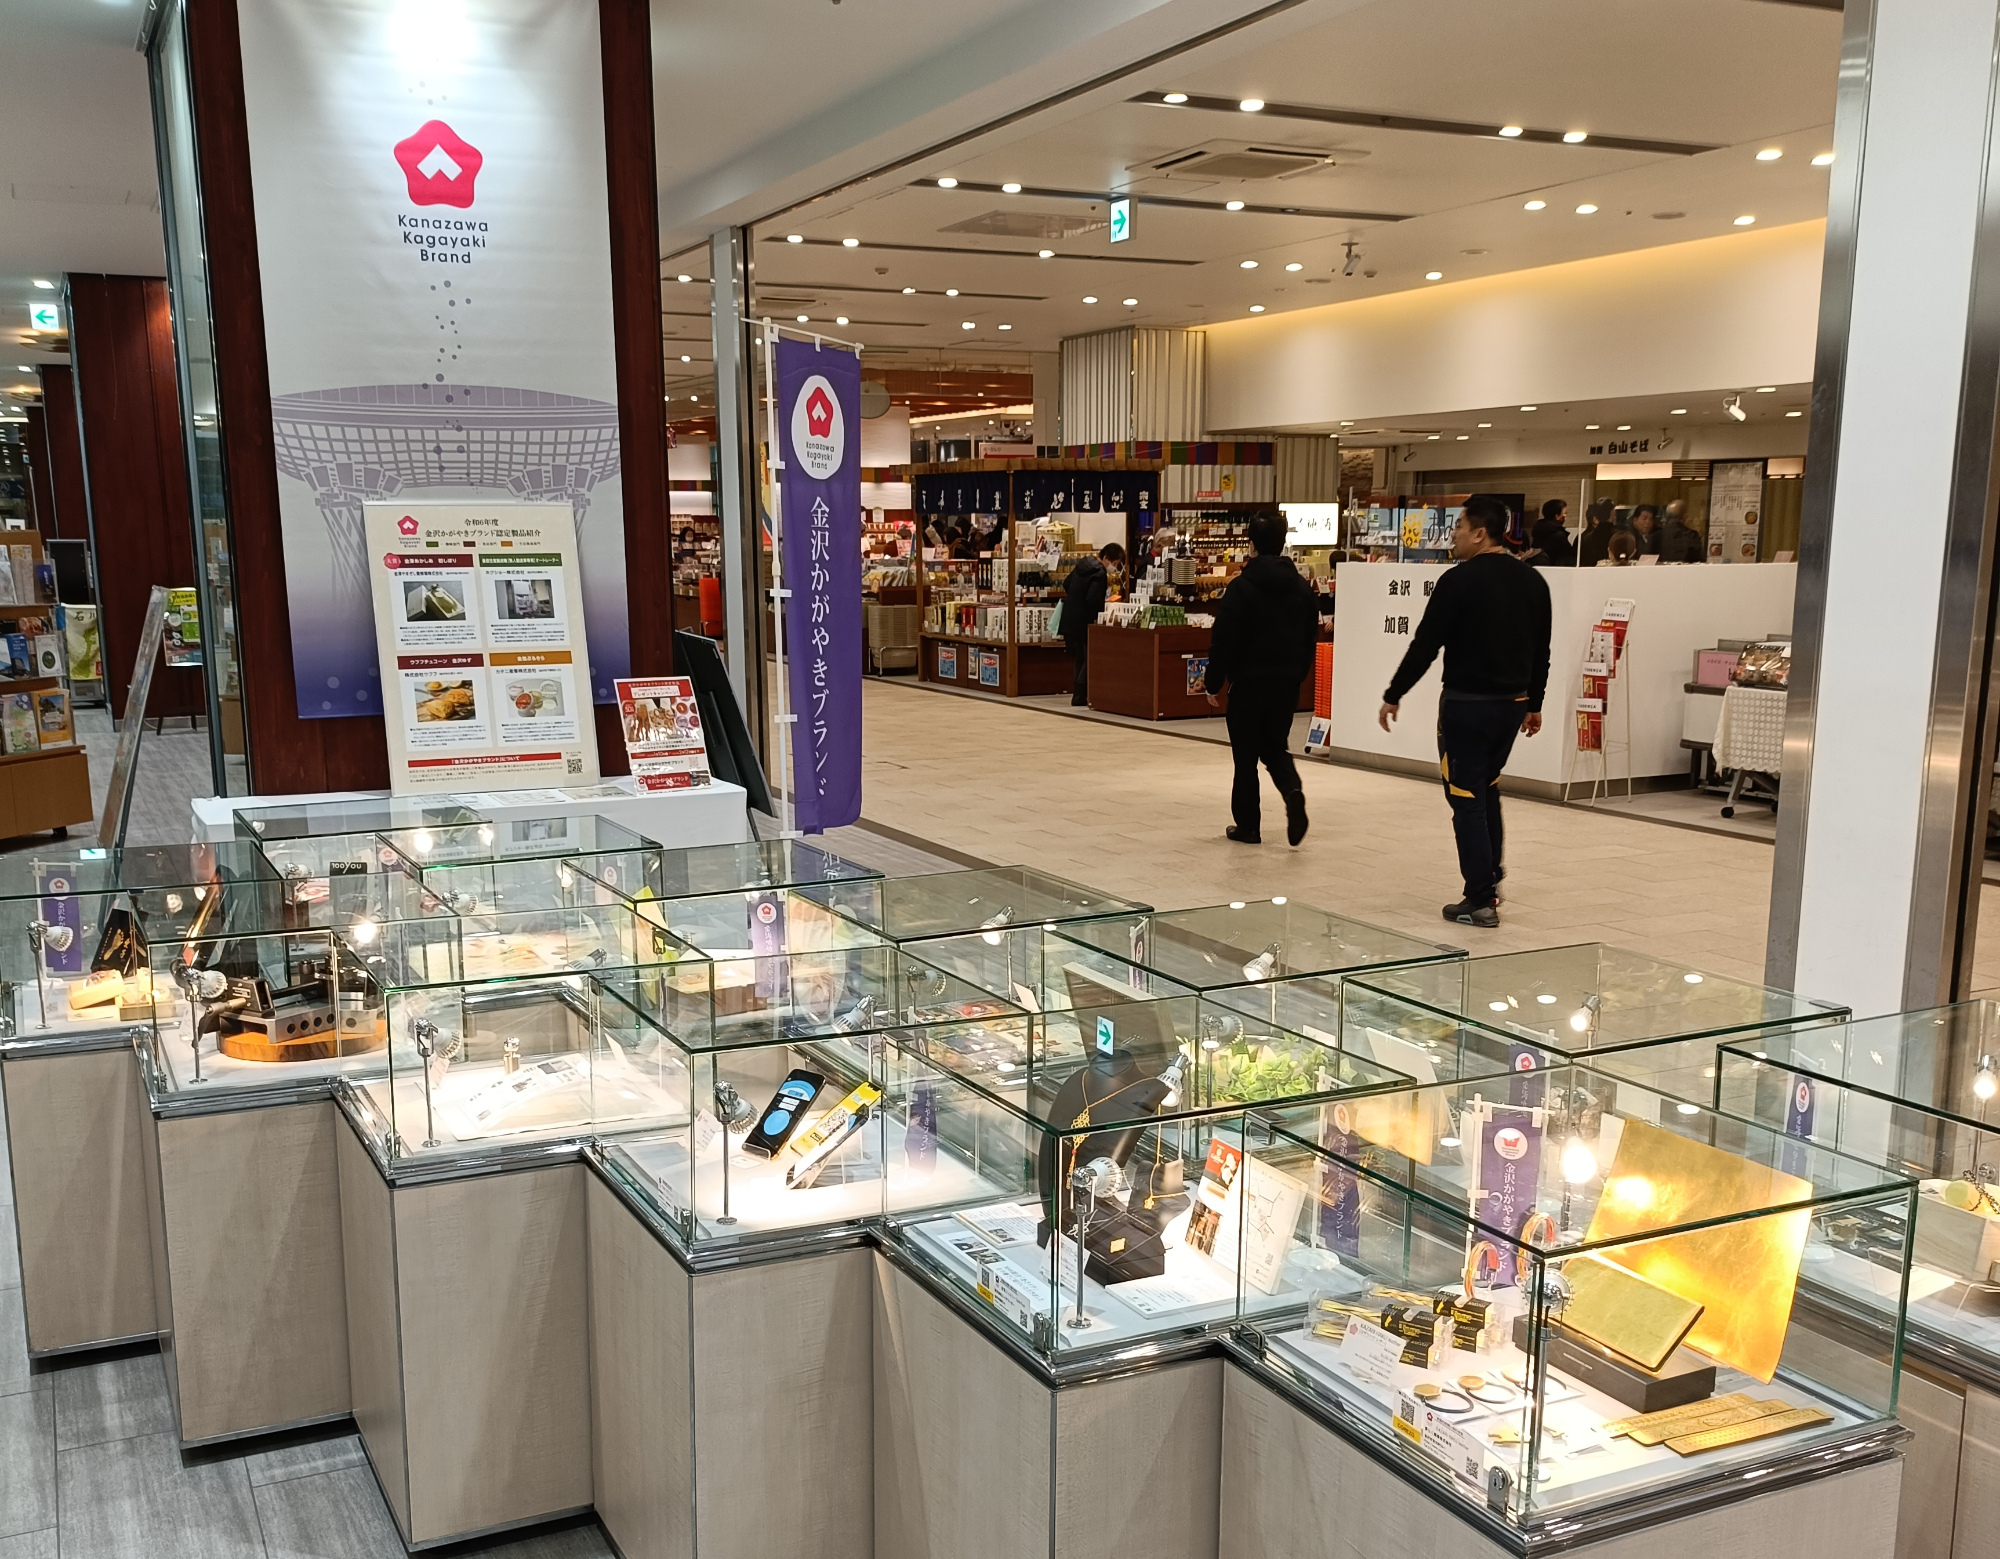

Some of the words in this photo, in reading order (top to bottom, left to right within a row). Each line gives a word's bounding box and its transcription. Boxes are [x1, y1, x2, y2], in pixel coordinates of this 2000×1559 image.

[398, 214, 488, 232] Kanazawa
[403, 231, 486, 249] Kagayaki
[420, 249, 471, 264] Brand
[806, 441, 835, 453] Kanazawa
[1608, 439, 1649, 455] 白山そば
[807, 451, 833, 462] Kagayaki
[811, 461, 828, 470] Brand
[464, 518, 500, 527] 令和6年度
[425, 529, 541, 538] 金沢かがやきブランド認定製品紹介
[1388, 579, 1411, 597] 金沢
[1384, 615, 1409, 635] 加賀
[810, 496, 830, 796] 金沢かがやきブランド
